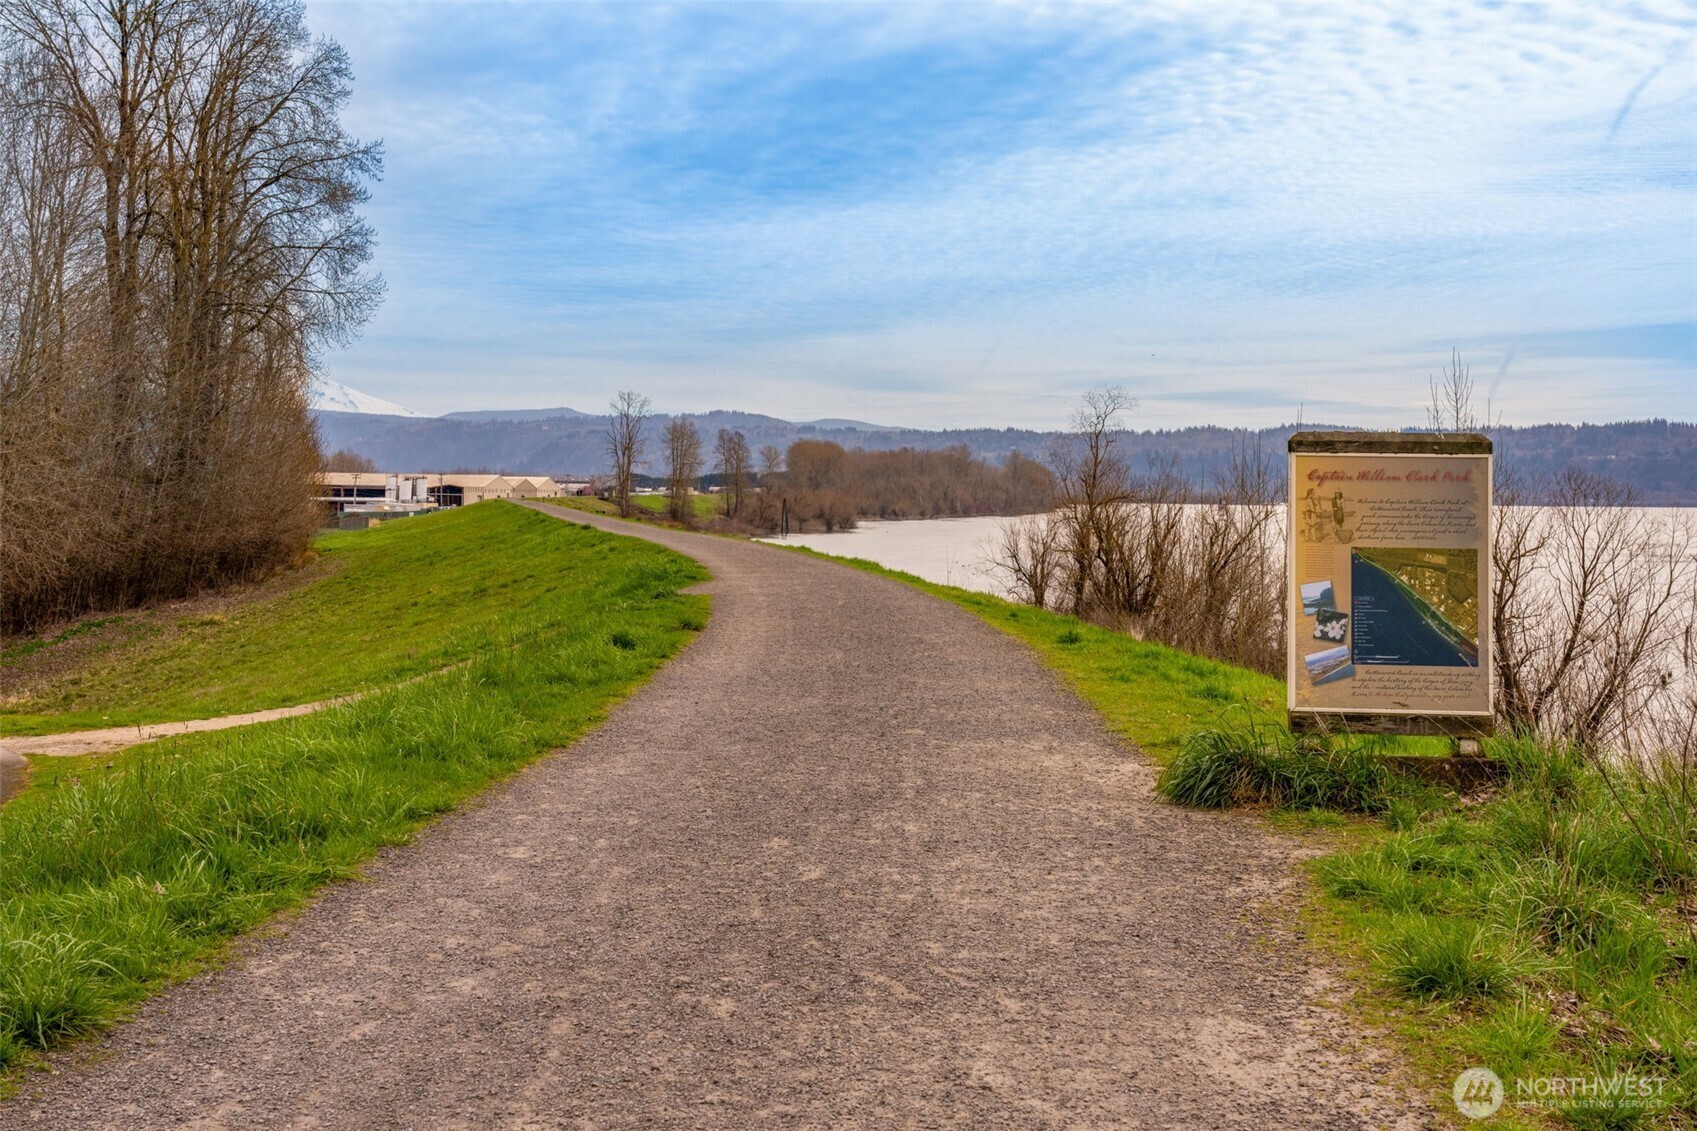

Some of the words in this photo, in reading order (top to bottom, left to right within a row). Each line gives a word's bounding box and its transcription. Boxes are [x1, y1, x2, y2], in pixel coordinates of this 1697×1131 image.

[1307, 469, 1352, 486] Captain
[1356, 468, 1401, 482] William
[1406, 469, 1438, 482] Clark
[1441, 469, 1472, 482] Park
